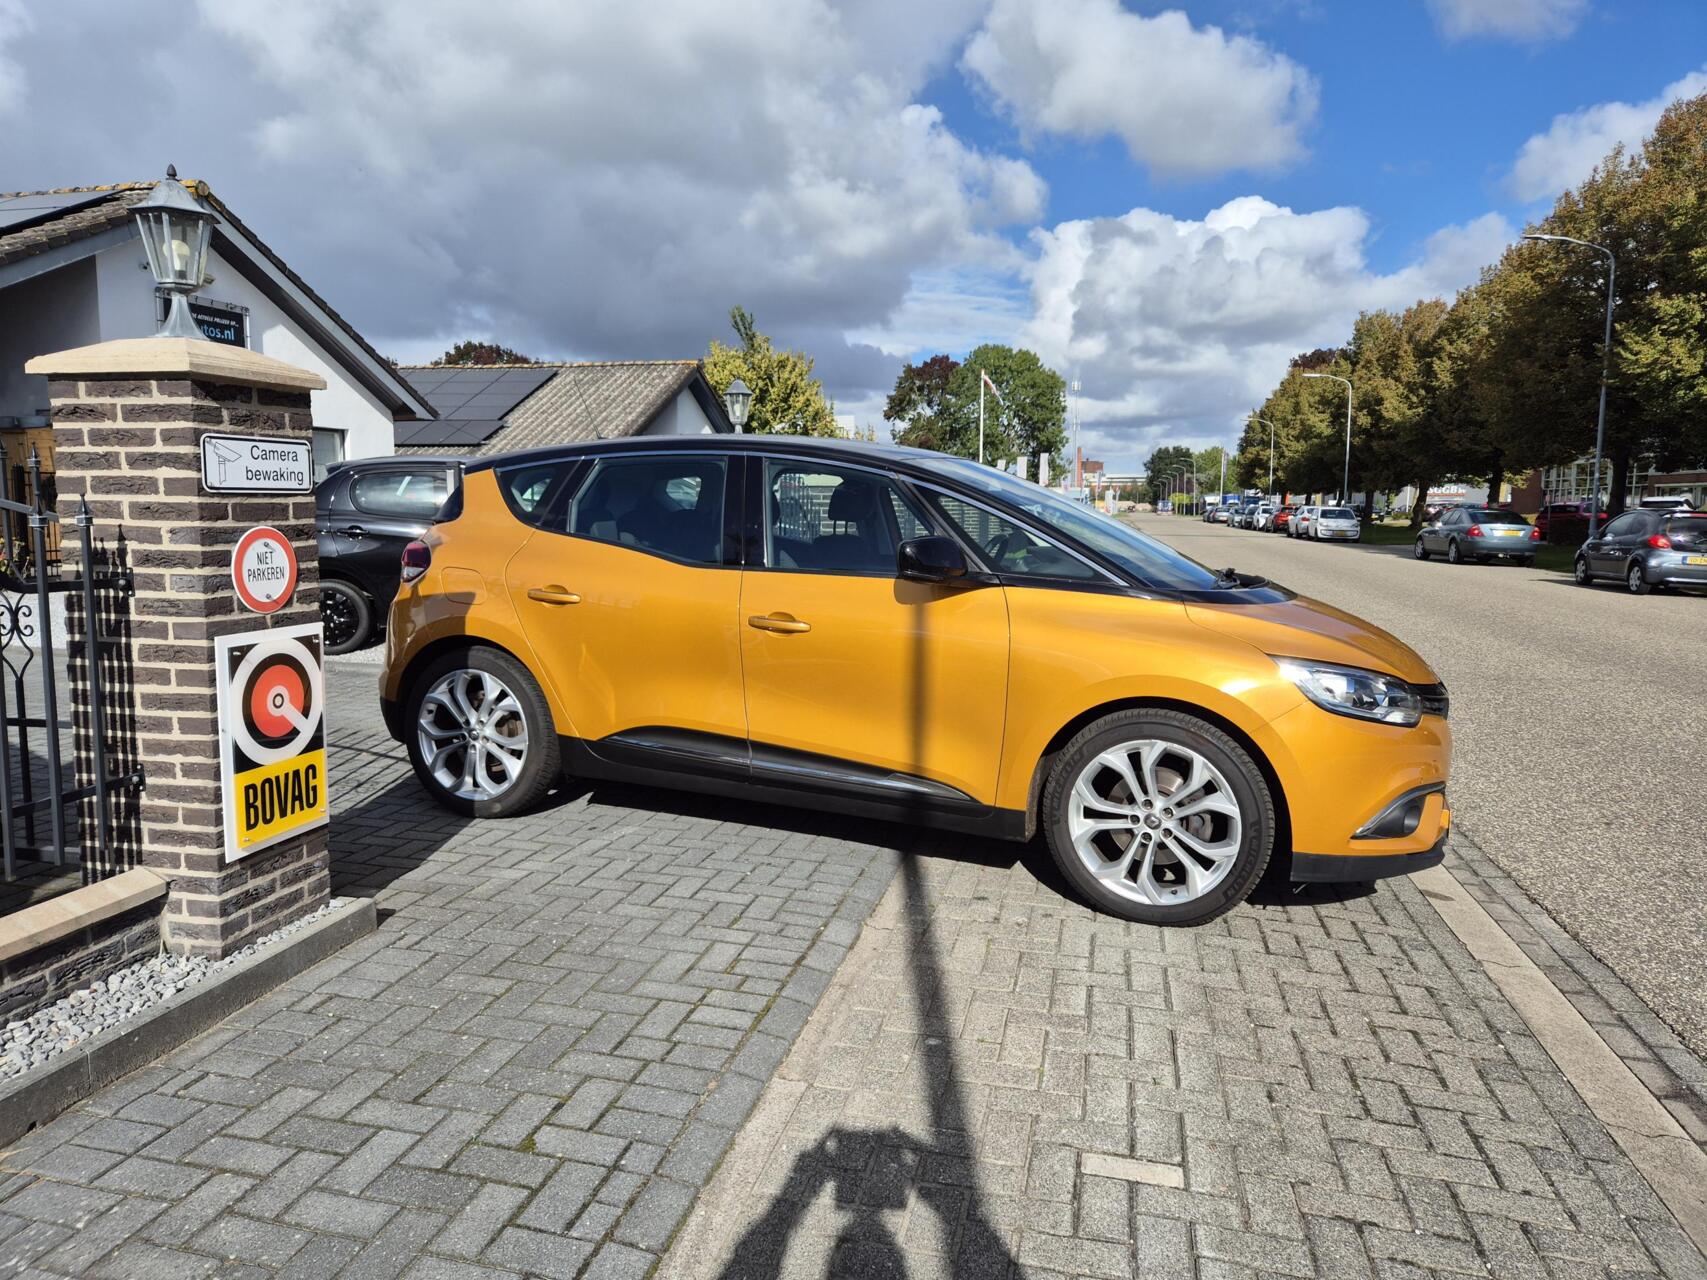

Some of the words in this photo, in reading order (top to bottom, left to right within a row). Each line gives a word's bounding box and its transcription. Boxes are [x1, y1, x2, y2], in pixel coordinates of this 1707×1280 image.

[250, 444, 299, 462] Camera
[245, 466, 304, 486] bewaking
[256, 551, 273, 566] NIET
[247, 566, 285, 582] PARKEREN
[244, 763, 318, 832] BOVAG
